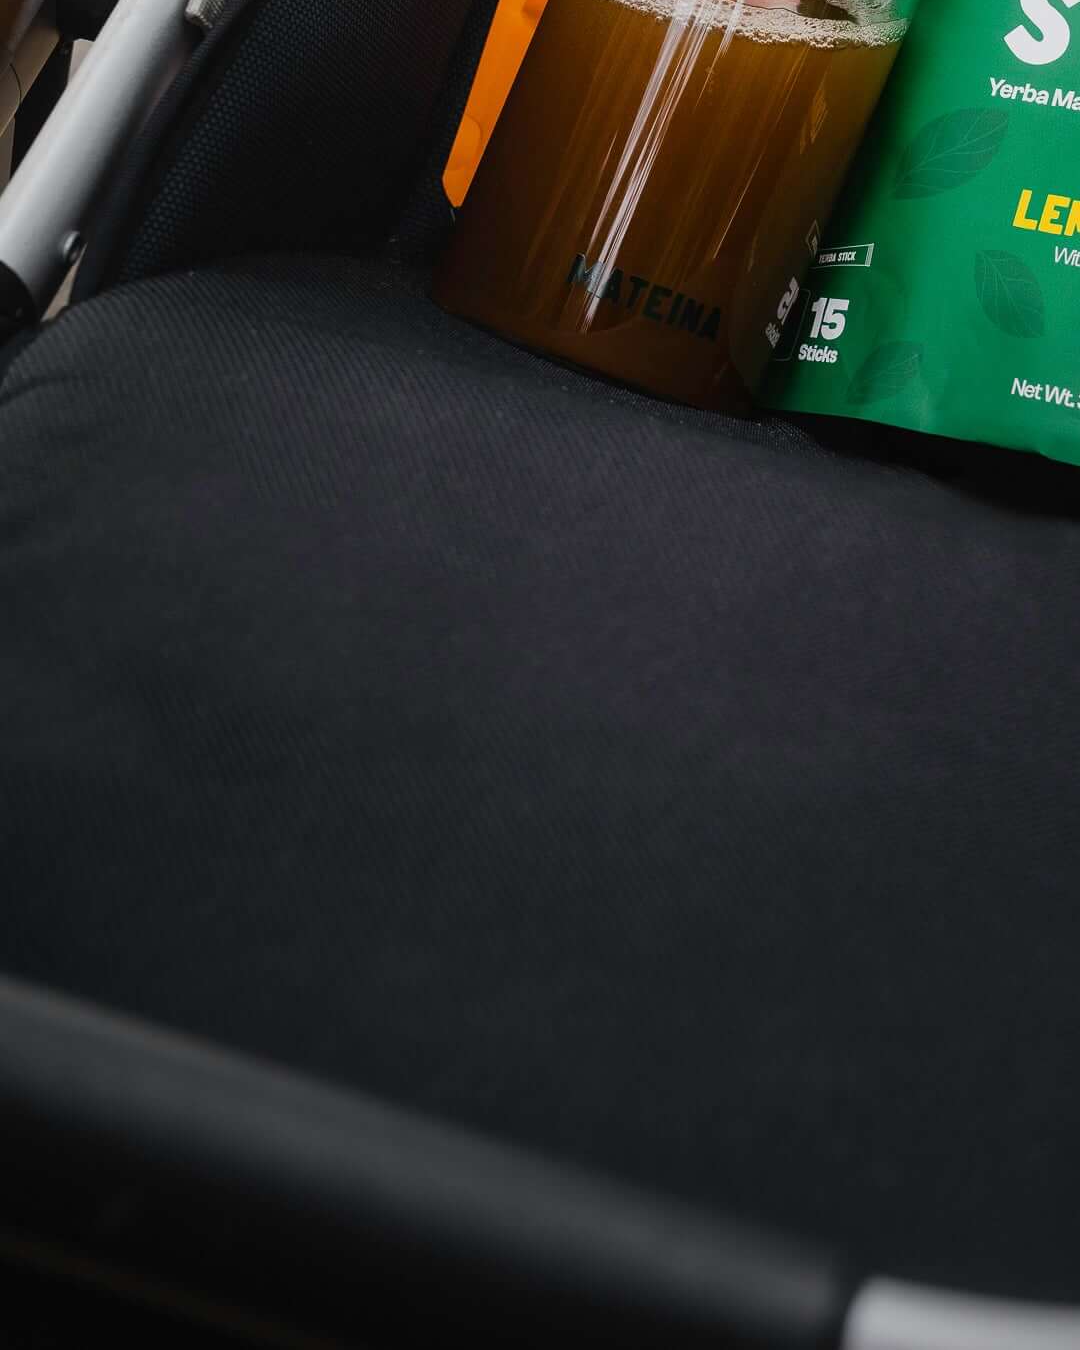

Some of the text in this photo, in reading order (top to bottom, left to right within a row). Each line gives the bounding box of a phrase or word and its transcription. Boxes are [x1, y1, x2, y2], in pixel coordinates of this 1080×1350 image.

[988, 77, 1050, 106] Yerba
[837, 251, 857, 262] STICK
[810, 297, 850, 340] 15
[798, 343, 839, 364] Sticks
[1010, 377, 1043, 400] Net
[1044, 384, 1074, 408] Wt.
